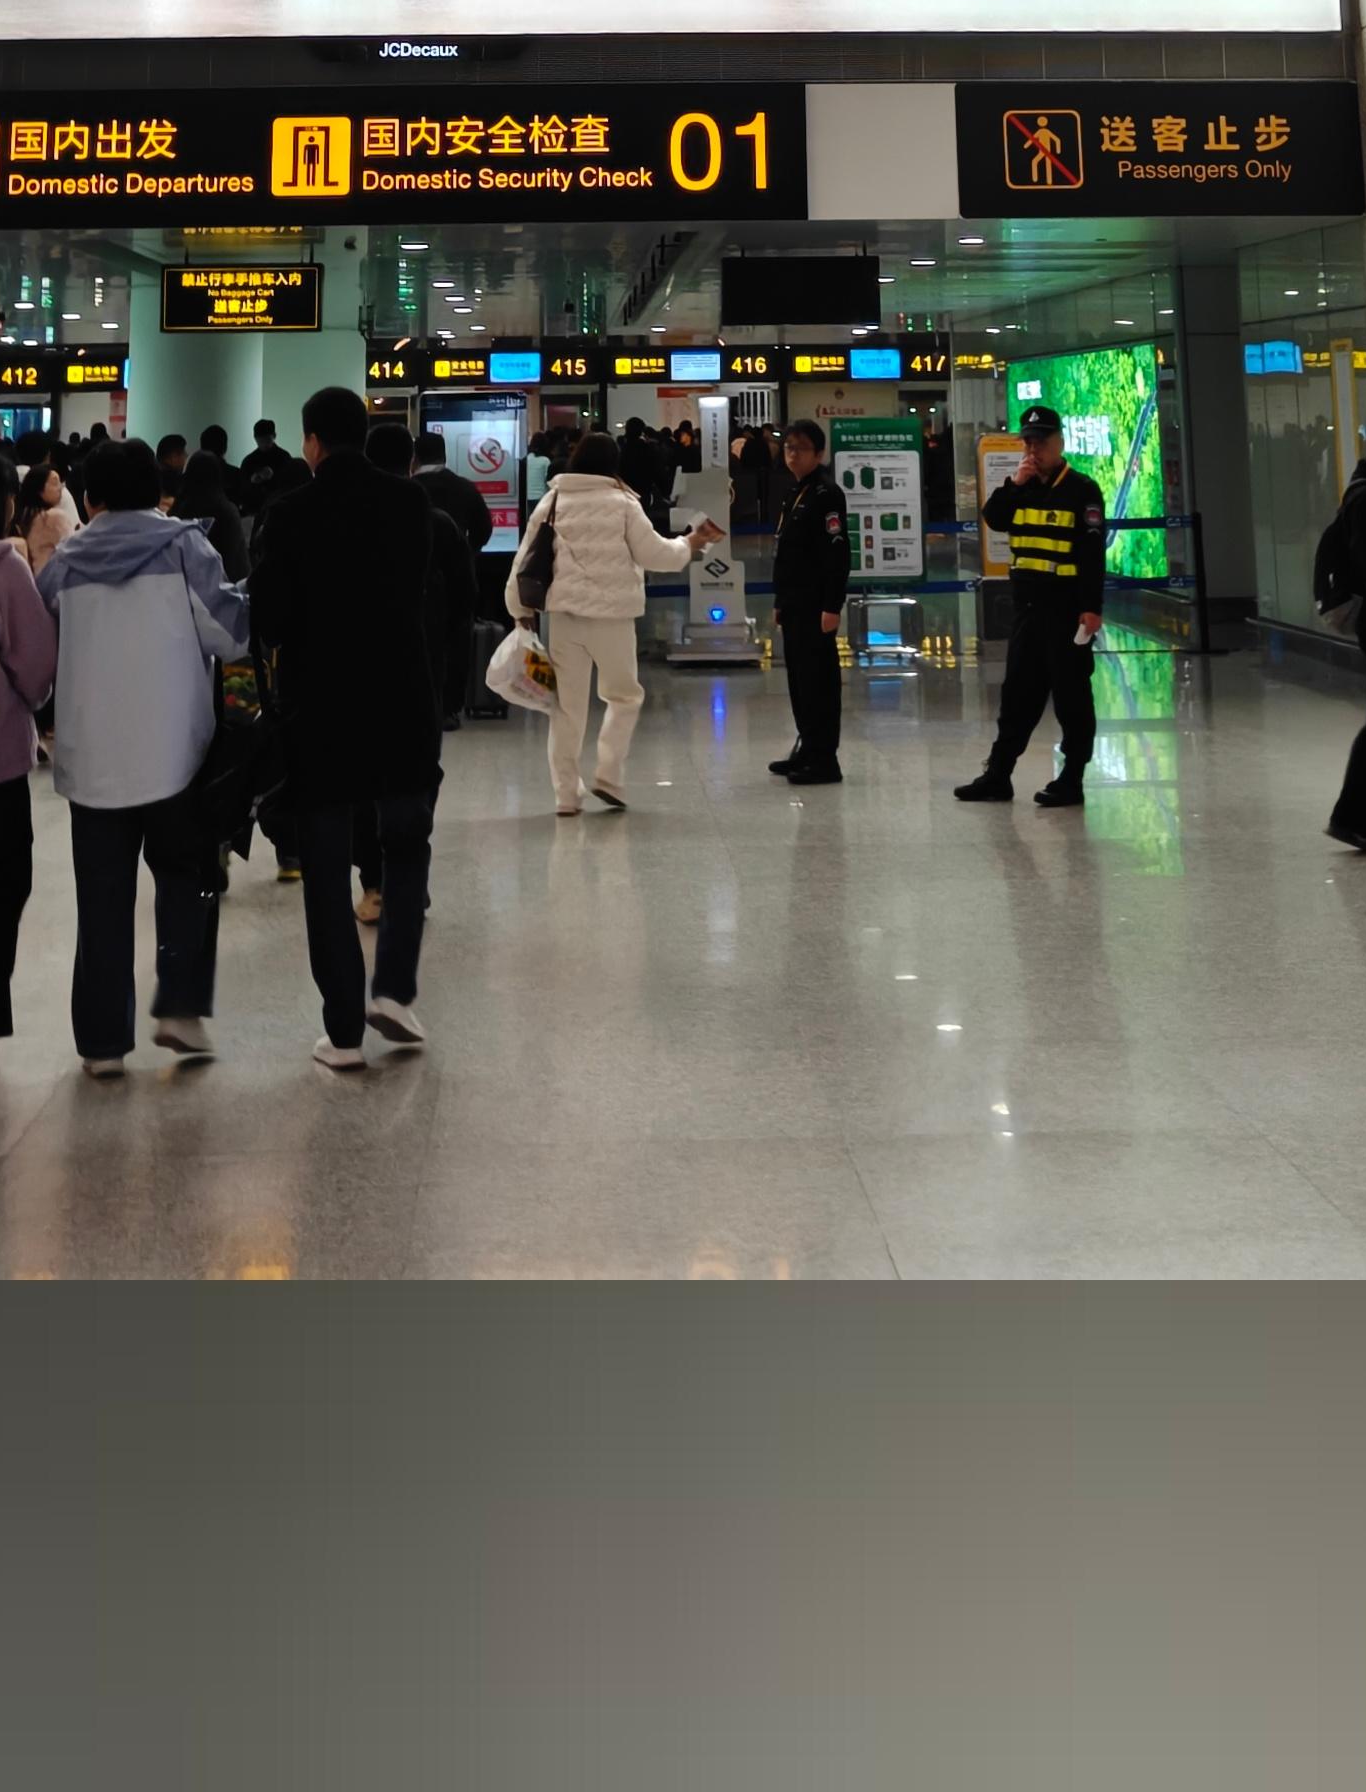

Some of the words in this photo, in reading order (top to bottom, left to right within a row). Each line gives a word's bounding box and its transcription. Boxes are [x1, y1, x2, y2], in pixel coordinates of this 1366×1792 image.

[378, 42, 459, 59] JCDecaux
[10, 119, 178, 161] 国内出发
[1099, 114, 1292, 154] 送客止步
[363, 114, 611, 158] 国内安全检查
[669, 111, 768, 192] 01
[362, 169, 472, 191] Domestic
[478, 167, 573, 193] Security
[579, 165, 653, 189] Check
[1118, 160, 1238, 183] Passengers
[1245, 160, 1293, 183] Only
[8, 173, 119, 195] Domestic
[126, 173, 254, 197] Departures
[1, 367, 38, 385] 412
[368, 360, 405, 379] 414
[550, 358, 587, 376] 415
[731, 356, 767, 374] 416
